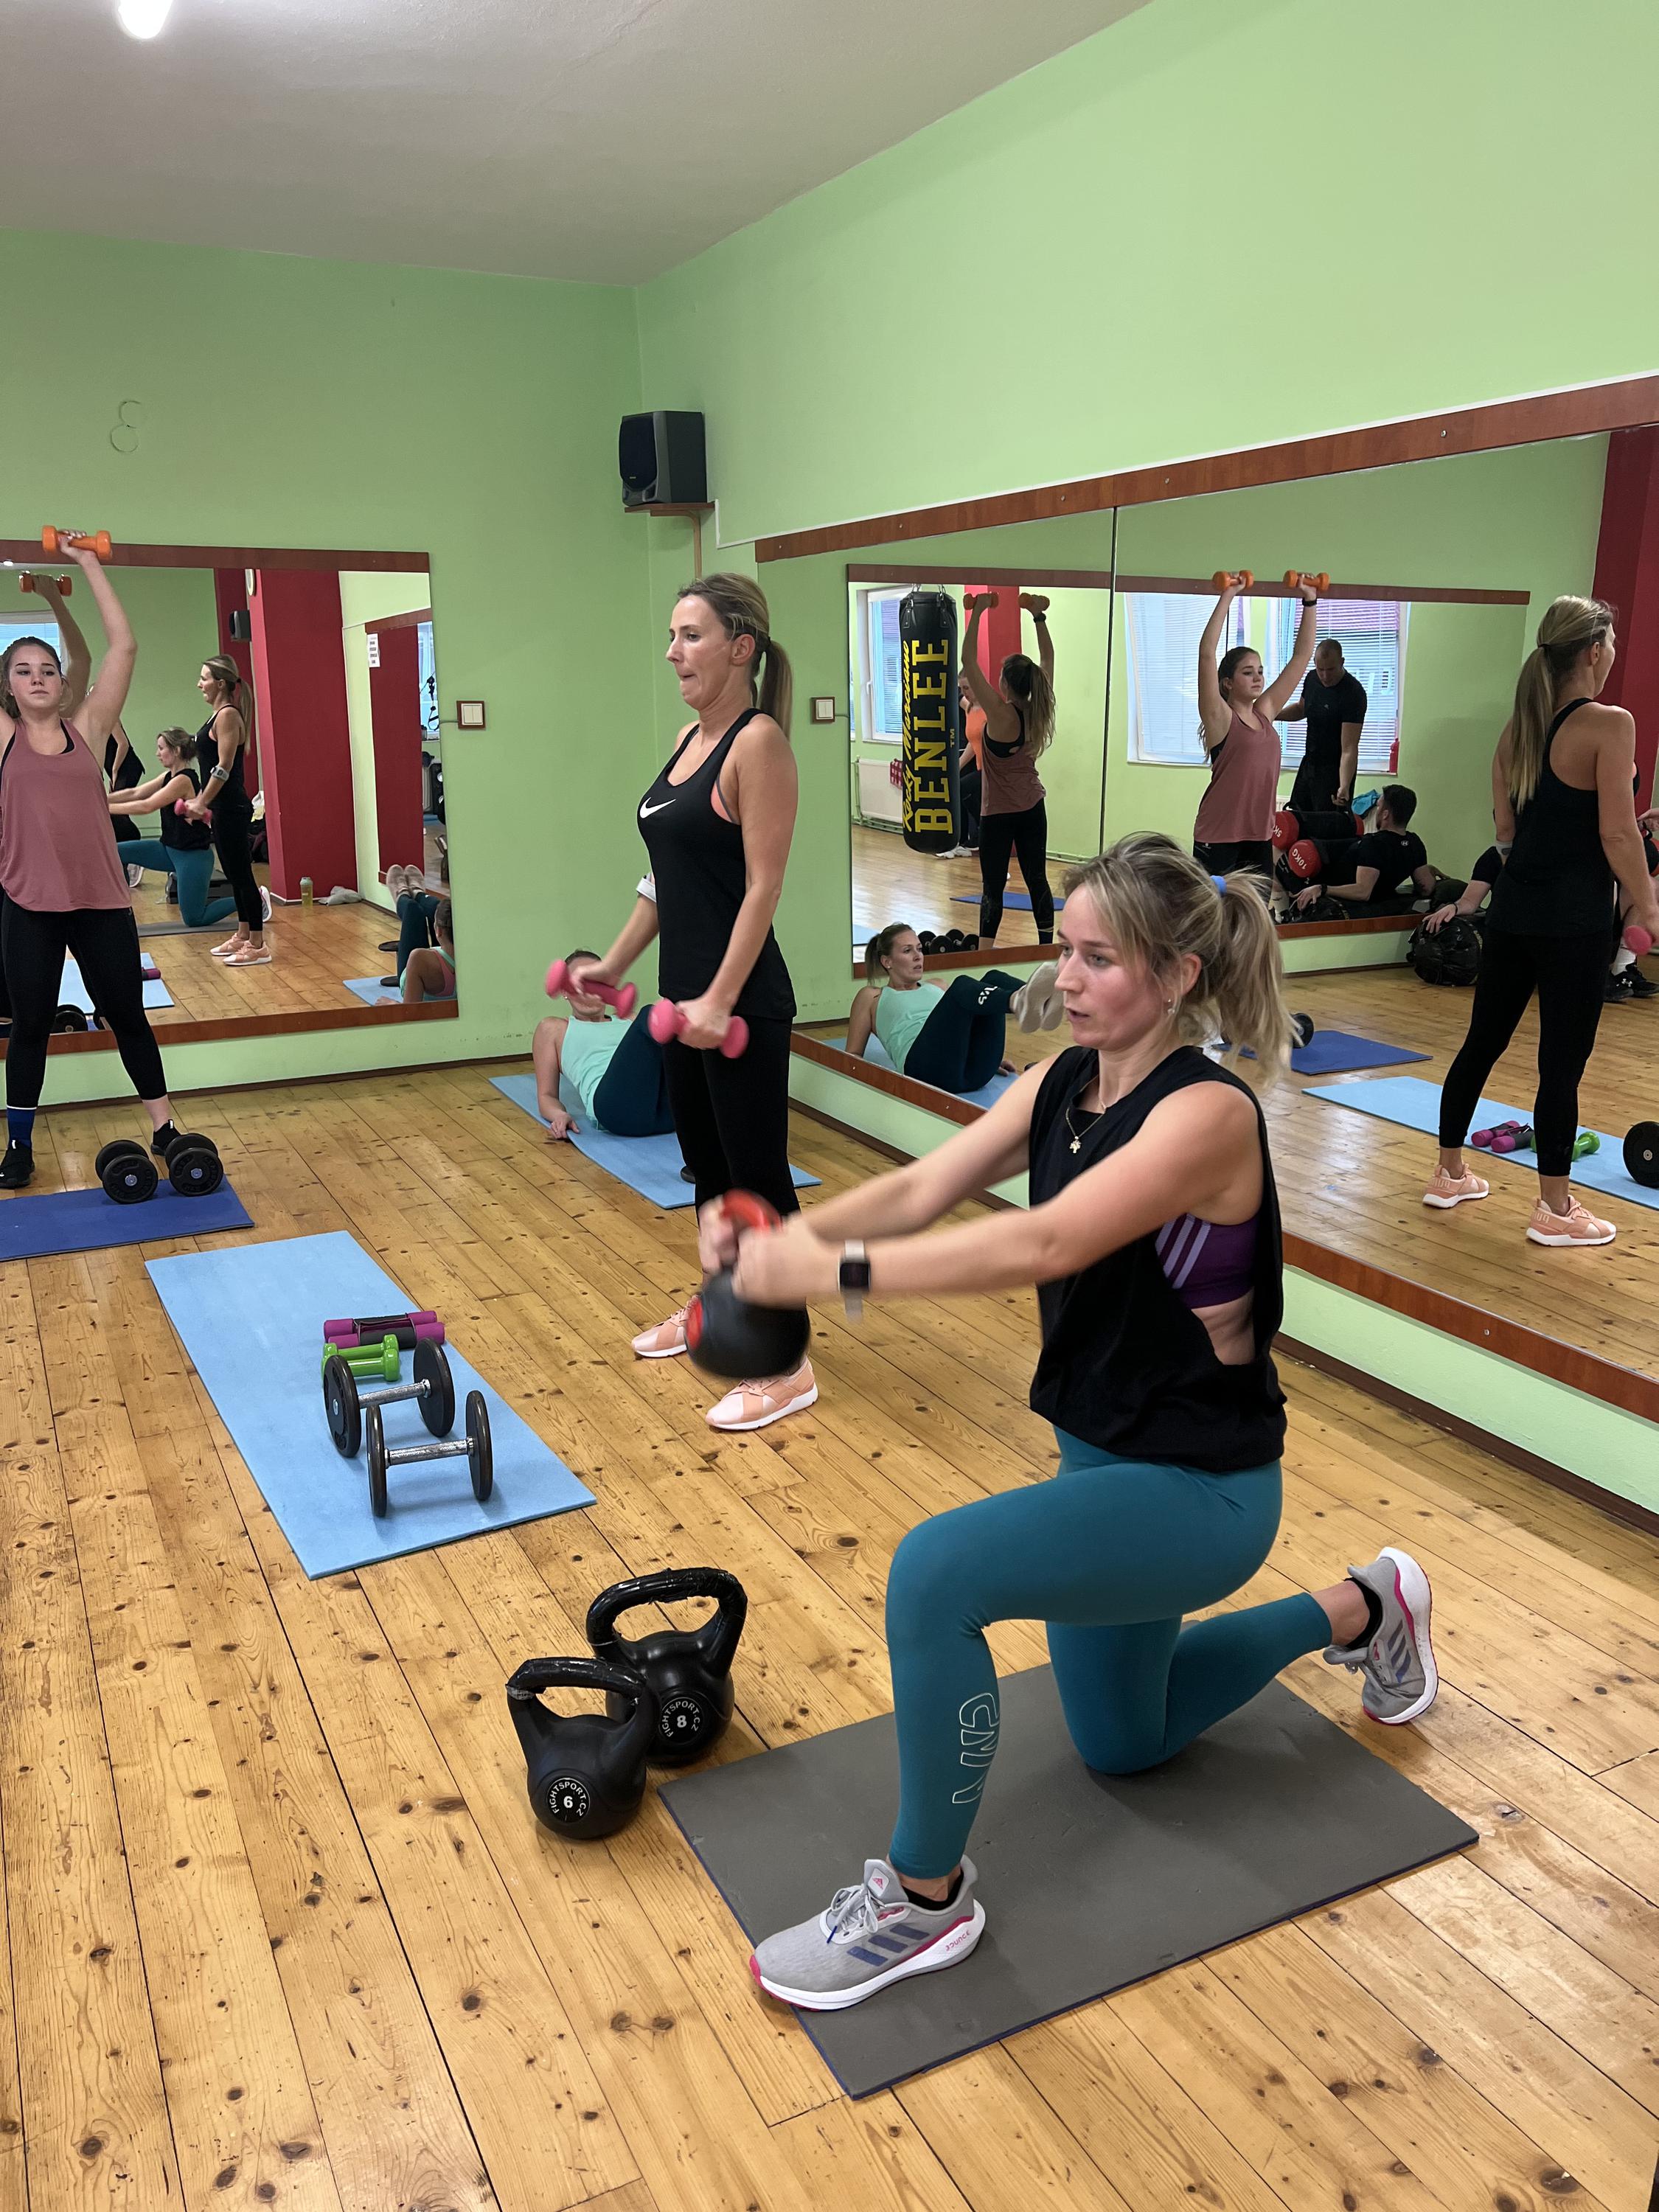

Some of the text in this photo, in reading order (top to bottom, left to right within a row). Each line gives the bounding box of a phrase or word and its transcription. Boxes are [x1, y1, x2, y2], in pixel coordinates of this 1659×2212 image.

[902, 640, 912, 761] Marciano
[911, 639, 953, 834] BENLEE
[1272, 825, 1282, 838] 5K
[1292, 848, 1307, 870] 10KG
[676, 1714, 687, 1728] 8
[563, 1795, 574, 1809] 6
